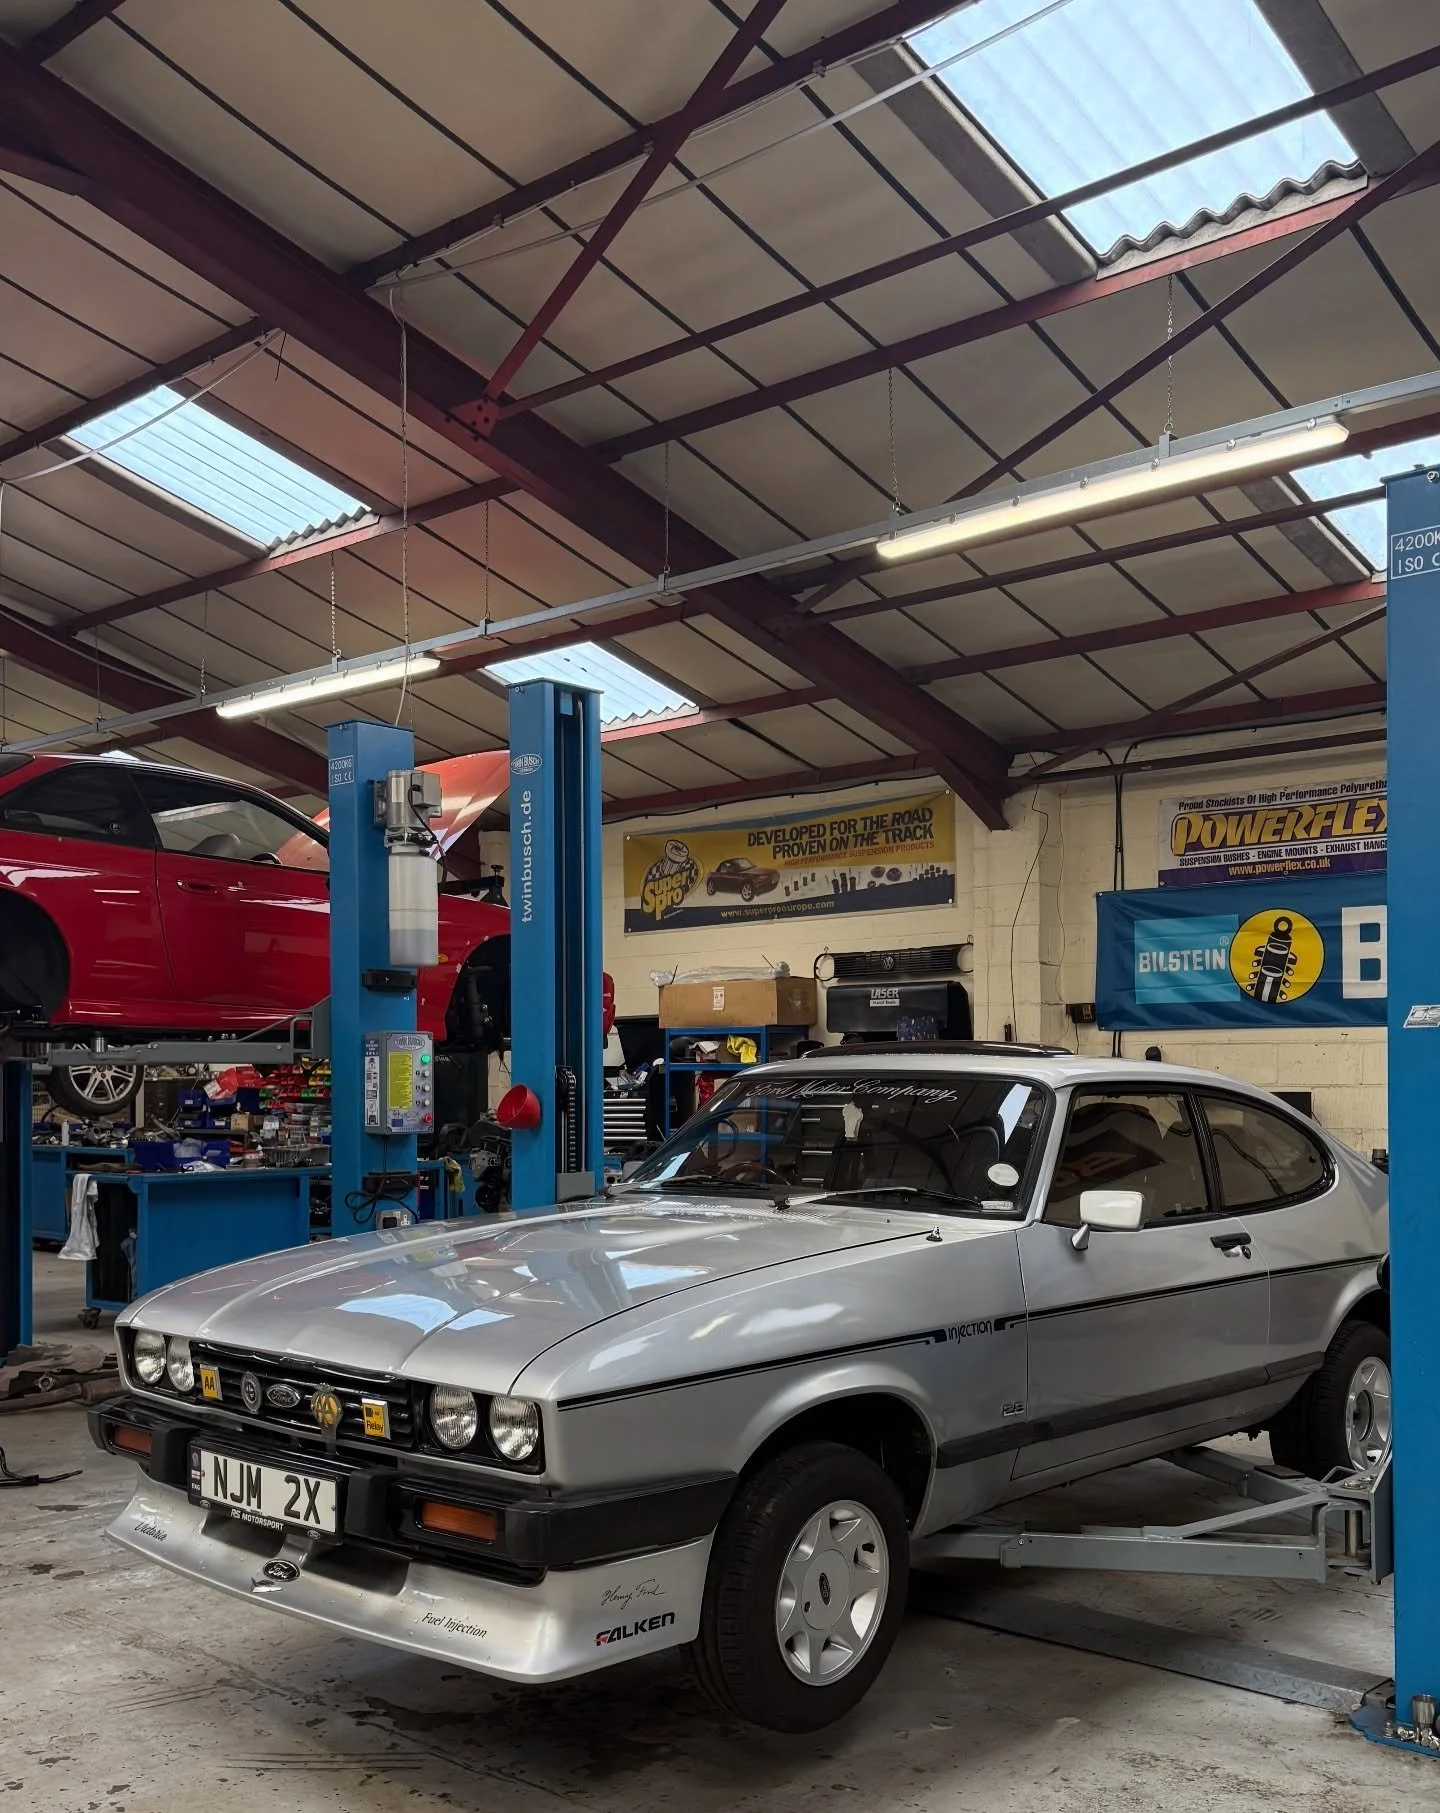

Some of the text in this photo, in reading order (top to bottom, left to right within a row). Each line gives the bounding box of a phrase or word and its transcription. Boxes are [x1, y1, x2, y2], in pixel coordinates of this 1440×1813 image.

[1398, 555, 1424, 574] ISO
[1179, 801, 1204, 811] Proud
[1206, 797, 1245, 808] Stockists
[1247, 794, 1257, 804] Of
[1259, 792, 1277, 804] High
[1280, 786, 1338, 801] Performance
[748, 807, 933, 847] DEVELOPED FOR THE ROAD
[772, 824, 935, 860] PROVEN ON THE TRACK
[784, 841, 935, 867] HIGH PERFORMANCE SUSPENSION PRODUCTS
[521, 789, 533, 924] twinbusch.de
[1180, 855, 1222, 867] SUSPENSION
[1223, 852, 1250, 862] BUSHES
[1257, 848, 1283, 859] ENGINE
[1284, 846, 1318, 857] MOUNTS
[1325, 842, 1361, 853] EXHAUST
[1228, 857, 1331, 876] www.powerflex.co.uk
[720, 900, 835, 918] www.superproeurope.com
[1138, 949, 1226, 973] BILSTEIN
[871, 988, 900, 999] LASER
[746, 1078, 958, 1104] Ford Motor Company
[204, 1375, 215, 1391] AA
[366, 1420, 384, 1433] Relay
[213, 1455, 321, 1525] NJM 2X
[134, 1521, 168, 1542] Victoria
[230, 1508, 284, 1532] RS MOTORSPORT
[268, 1562, 293, 1580] Ford
[421, 1612, 488, 1638] Fuel Injection
[595, 1611, 675, 1646] FALKEN
